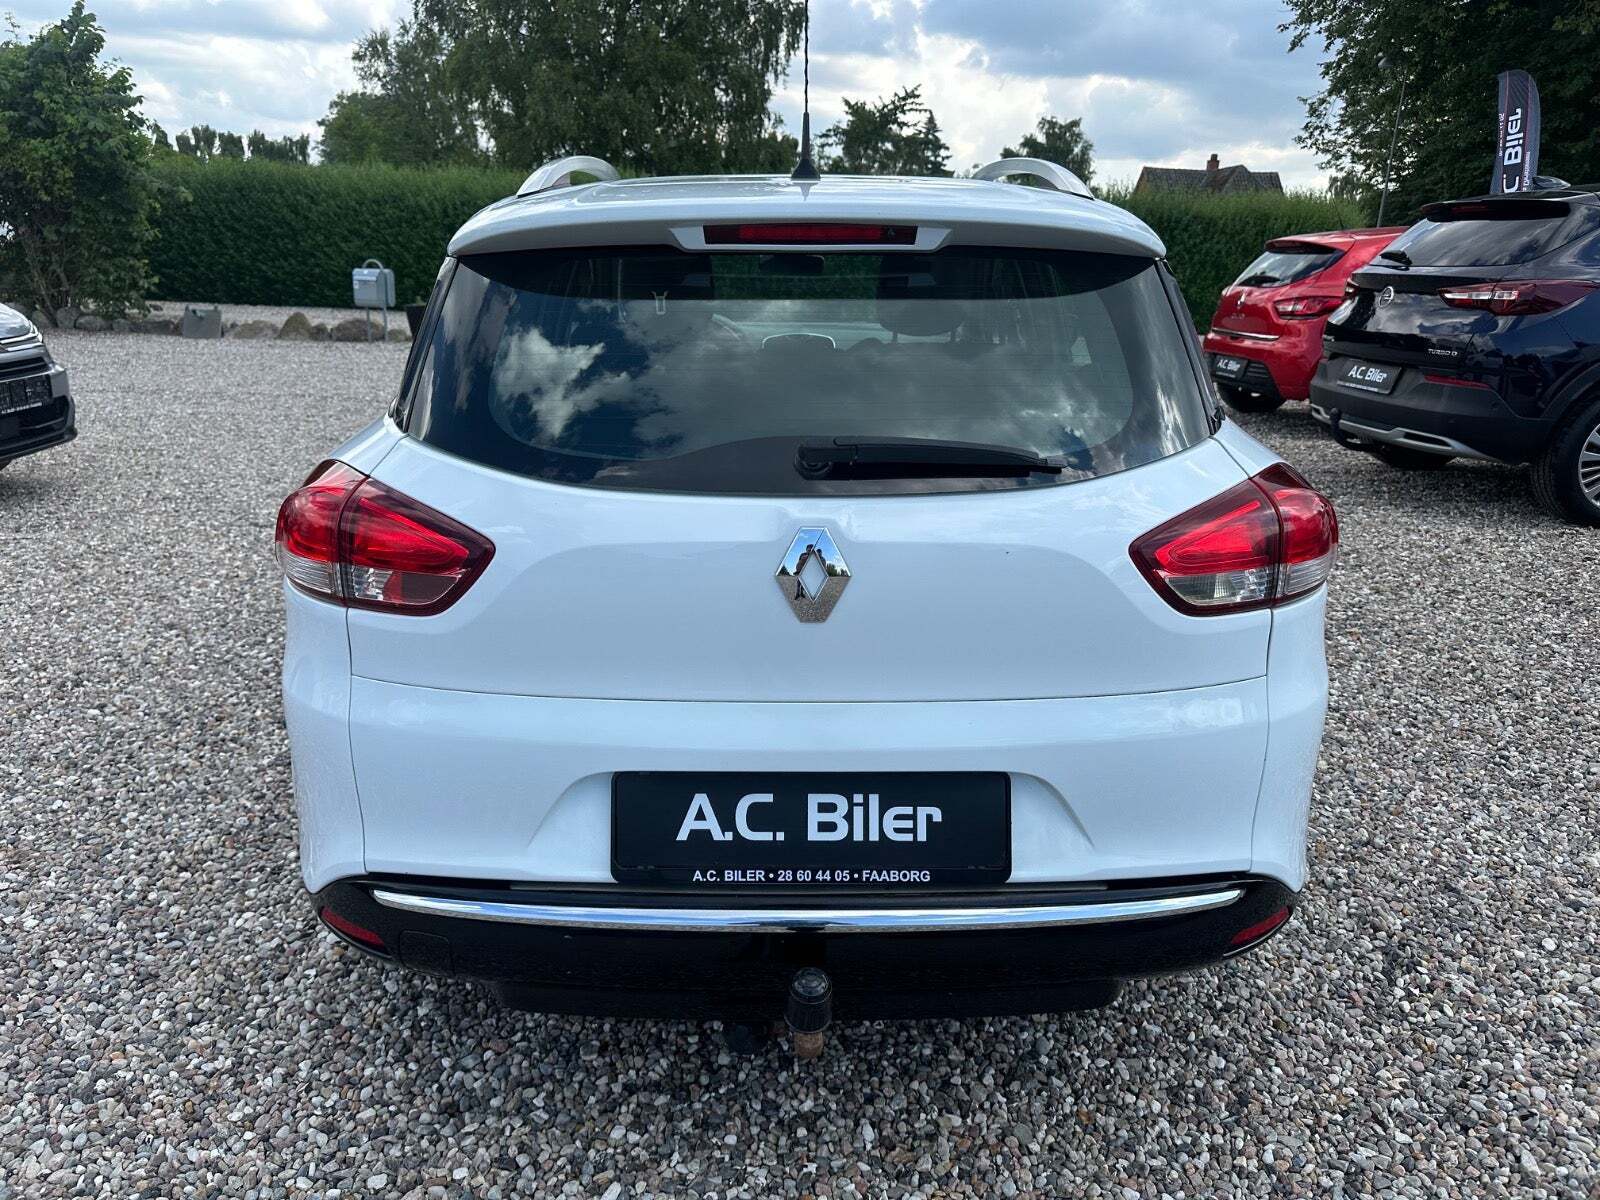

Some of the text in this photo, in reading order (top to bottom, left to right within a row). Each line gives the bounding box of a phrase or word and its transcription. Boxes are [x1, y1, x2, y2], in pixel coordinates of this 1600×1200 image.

[675, 793, 943, 842] A.C. Biler
[692, 870, 931, 882] A.C. BILER 28 60 44 05 FAABORG
